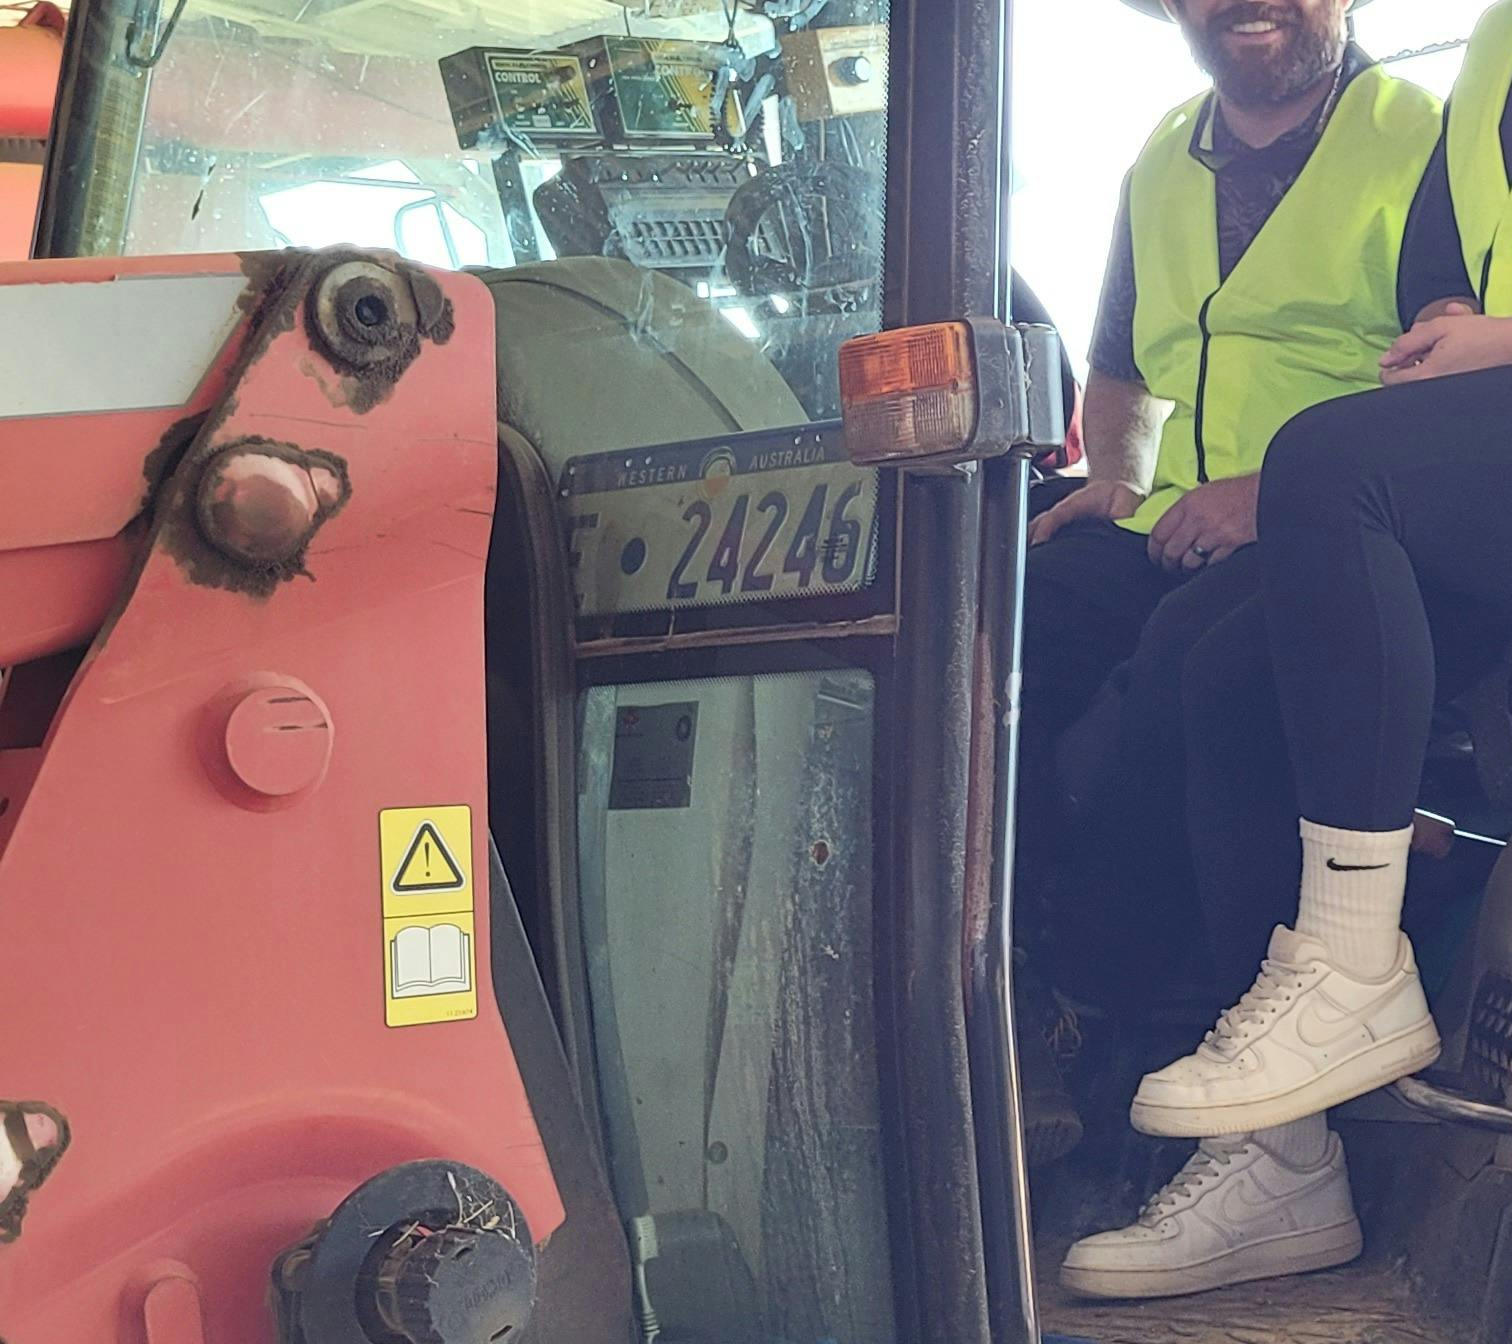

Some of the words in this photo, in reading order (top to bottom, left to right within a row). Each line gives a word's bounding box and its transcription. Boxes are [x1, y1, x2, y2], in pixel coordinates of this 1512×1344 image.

[495, 71, 542, 84] CONTROL
[617, 463, 688, 487] WESTERN
[749, 446, 825, 470] AUSTRALIA
[666, 481, 863, 600] 24246
